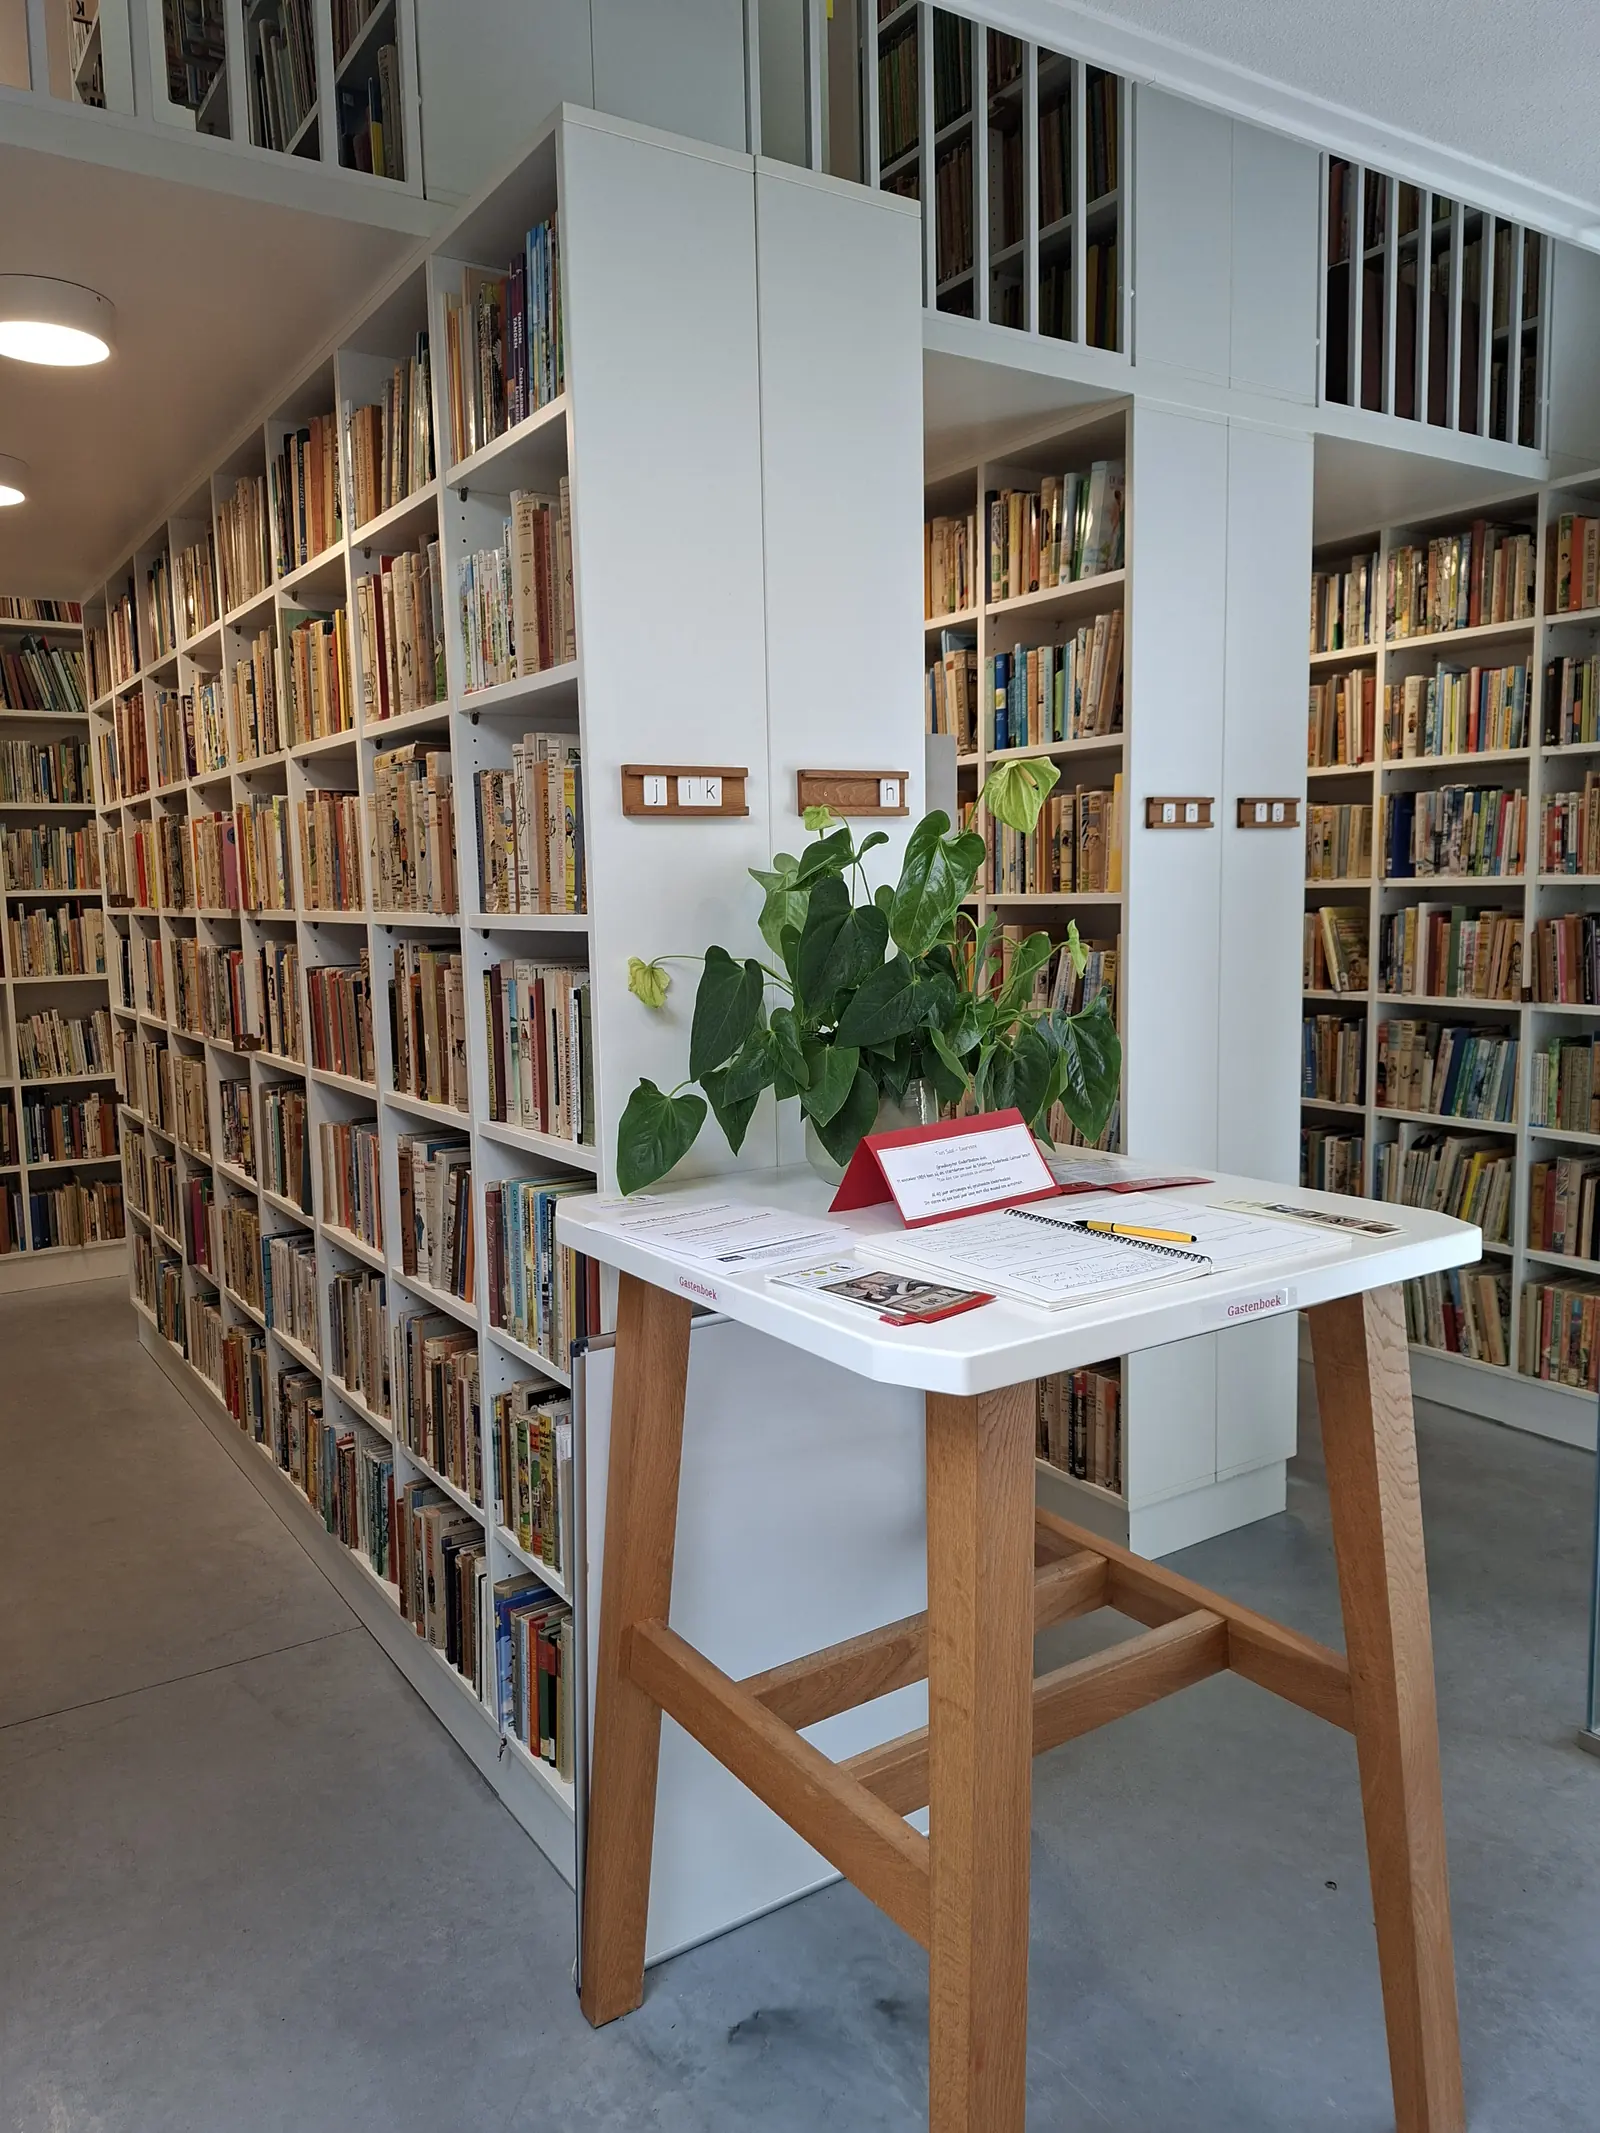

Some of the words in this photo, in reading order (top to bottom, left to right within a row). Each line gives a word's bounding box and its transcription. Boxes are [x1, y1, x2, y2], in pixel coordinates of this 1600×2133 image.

[652, 778, 659, 804] j
[886, 782, 896, 801] h
[239, 1037, 250, 1049] K
[679, 1275, 718, 1301] Gastenboek
[1227, 1294, 1282, 1317] Gastenboek
